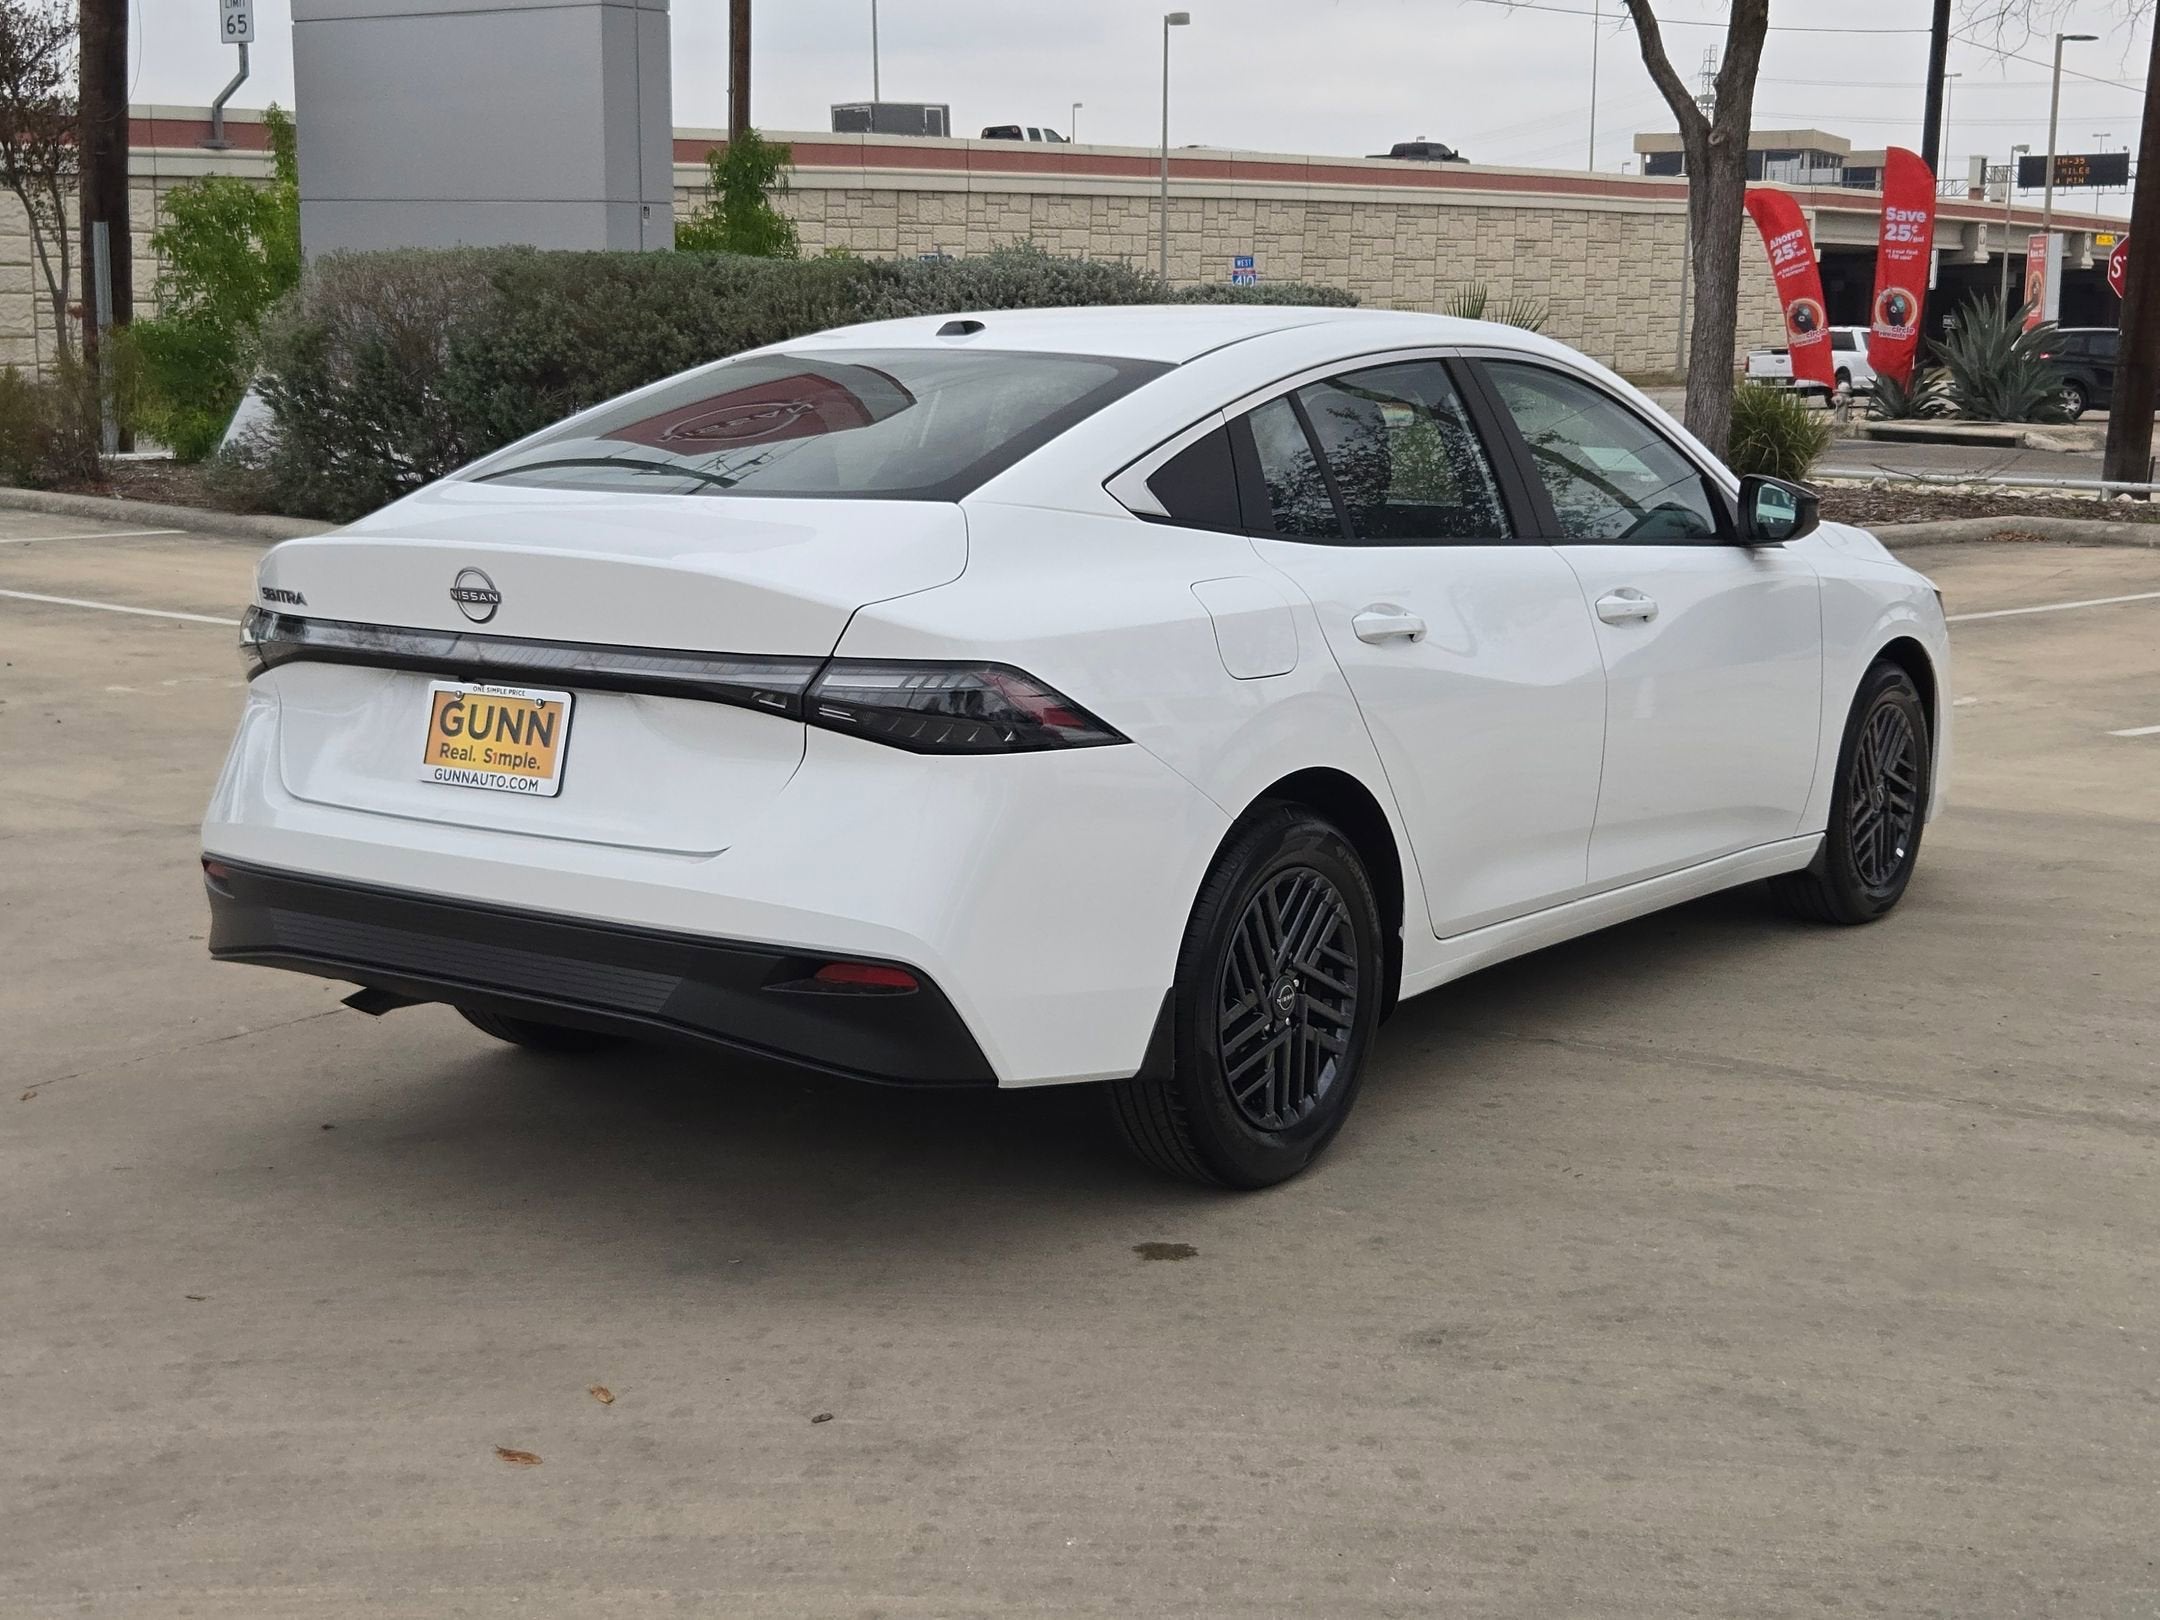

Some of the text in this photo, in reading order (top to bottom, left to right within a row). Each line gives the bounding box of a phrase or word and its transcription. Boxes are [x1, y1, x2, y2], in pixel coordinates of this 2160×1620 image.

[227, 14, 247, 35] 65
[1886, 206, 1927, 223] Save
[1770, 229, 1803, 250] Ahorra
[1235, 275, 1255, 288] 410
[450, 589, 499, 603] NISSAN
[487, 687, 506, 695] SIMPLE
[508, 689, 526, 697] PRICE
[439, 701, 556, 748] GUNN
[440, 743, 476, 762] Real.
[434, 768, 539, 792] GUNNAUTO.COM
